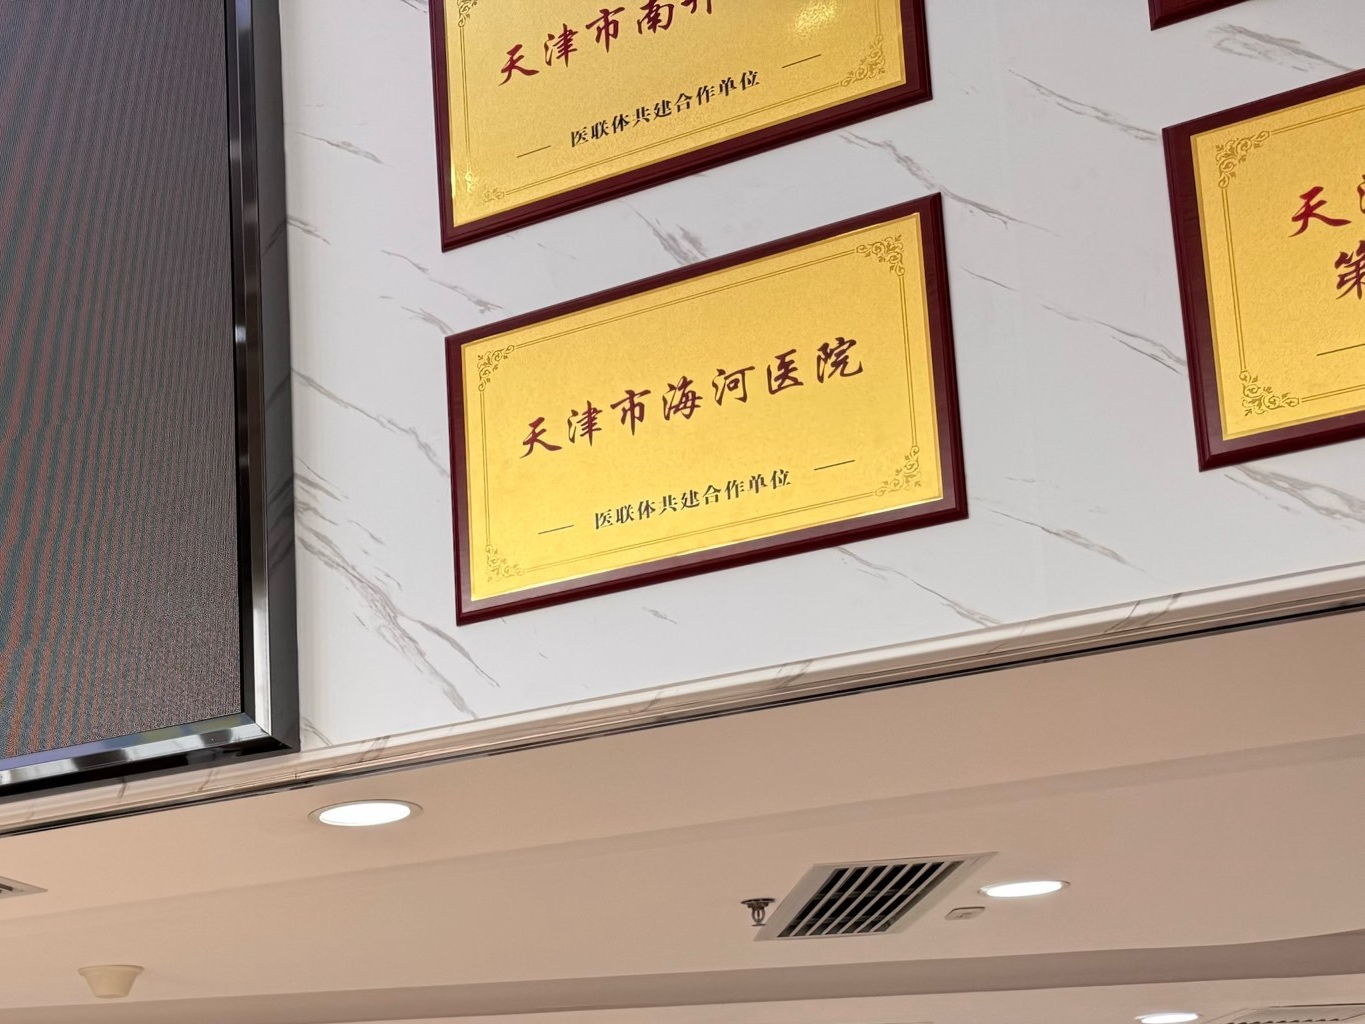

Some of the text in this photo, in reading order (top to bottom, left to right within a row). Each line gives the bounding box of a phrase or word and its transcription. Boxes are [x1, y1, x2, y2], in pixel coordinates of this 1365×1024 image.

[570, 69, 761, 148] 医联体共建合作单位
[1287, 174, 1365, 238] 天
[519, 336, 864, 459] 天津市海河医院
[594, 468, 792, 530] 医联体共建合作单位
